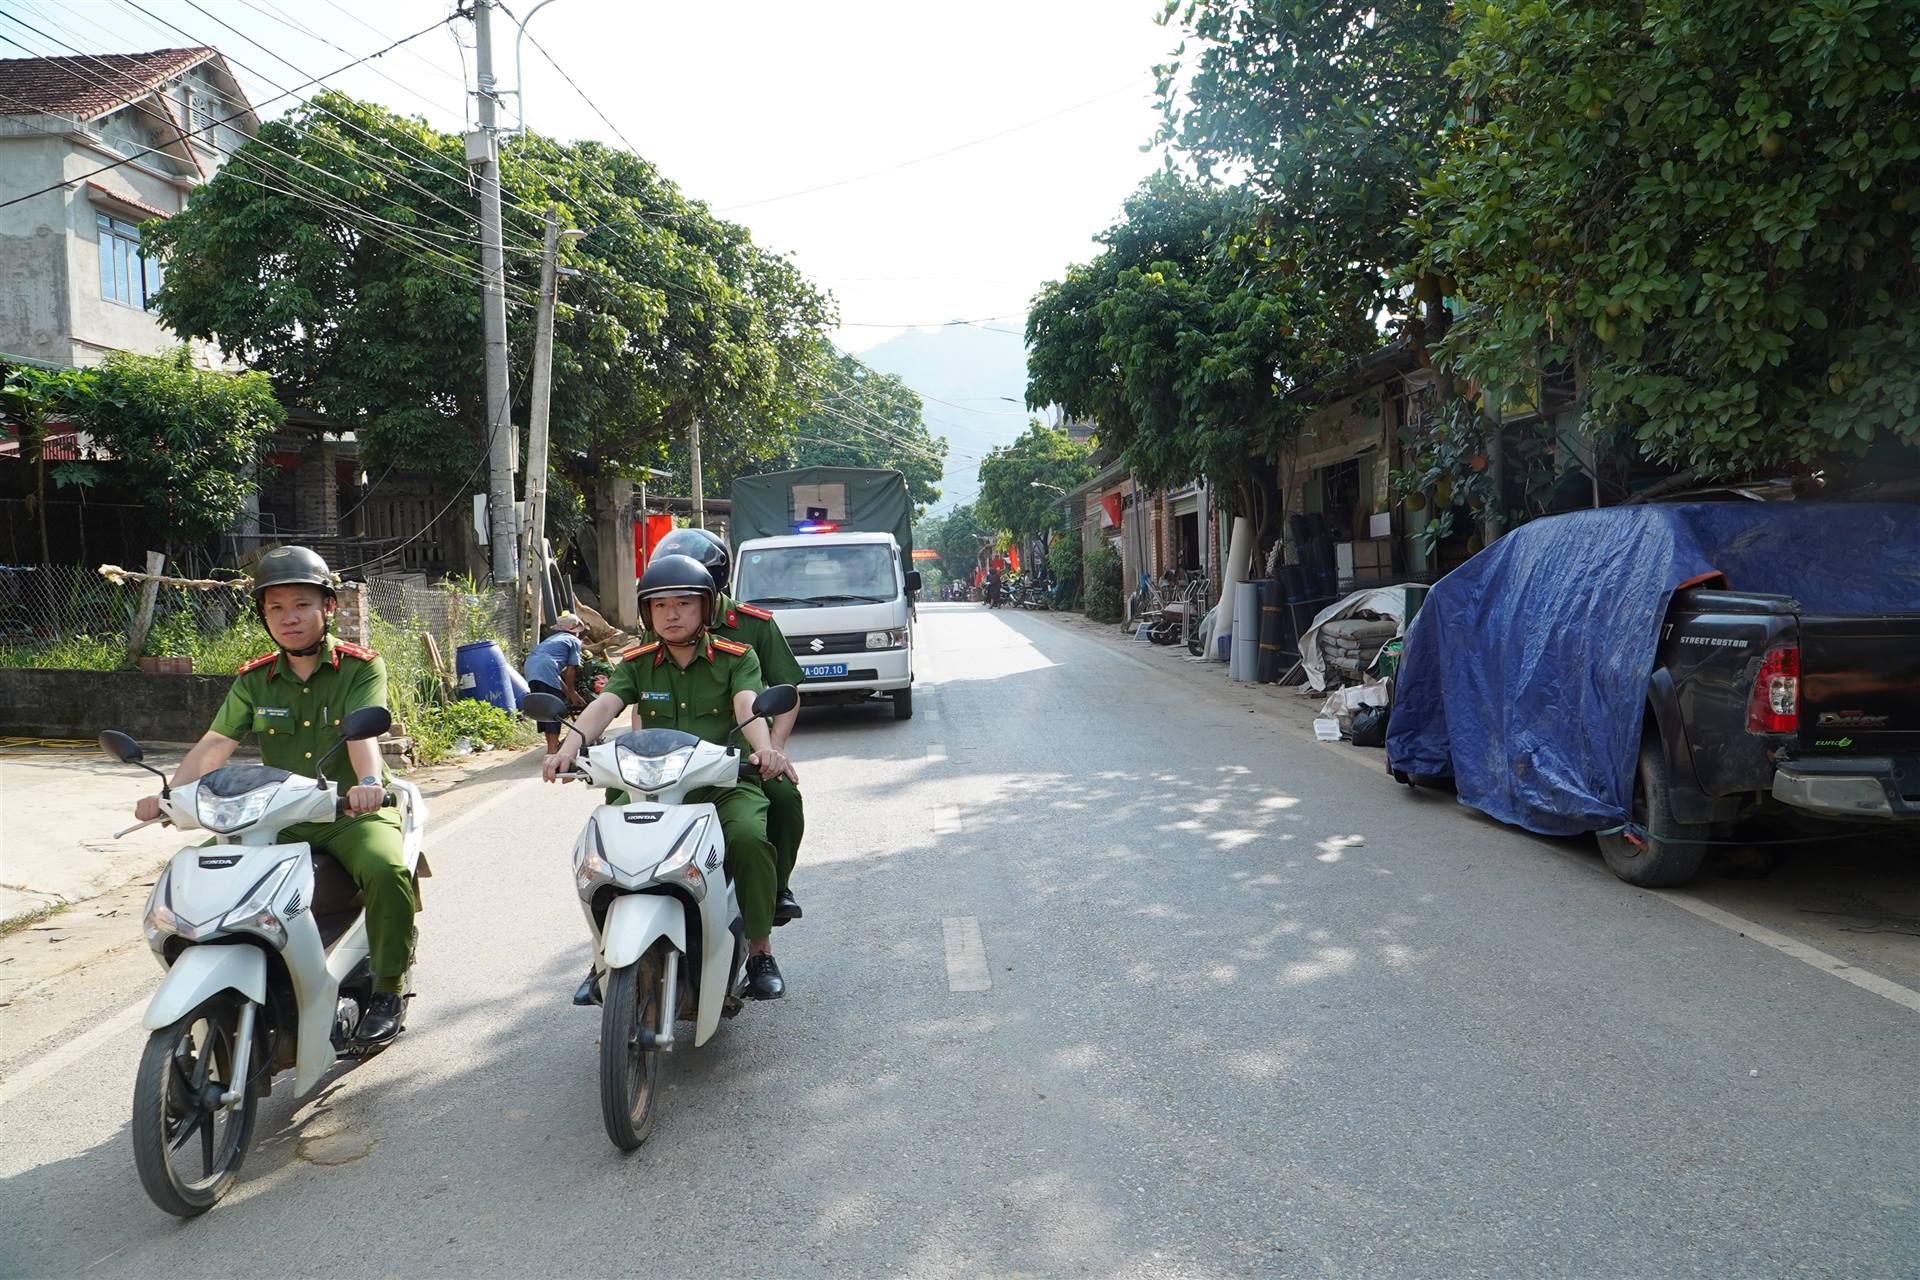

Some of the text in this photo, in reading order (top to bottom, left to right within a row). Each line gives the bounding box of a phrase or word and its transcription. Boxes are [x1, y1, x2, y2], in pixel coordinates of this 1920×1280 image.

[1680, 636, 1748, 648] STREET CUSTOM
[286, 905, 309, 922] HONDA
